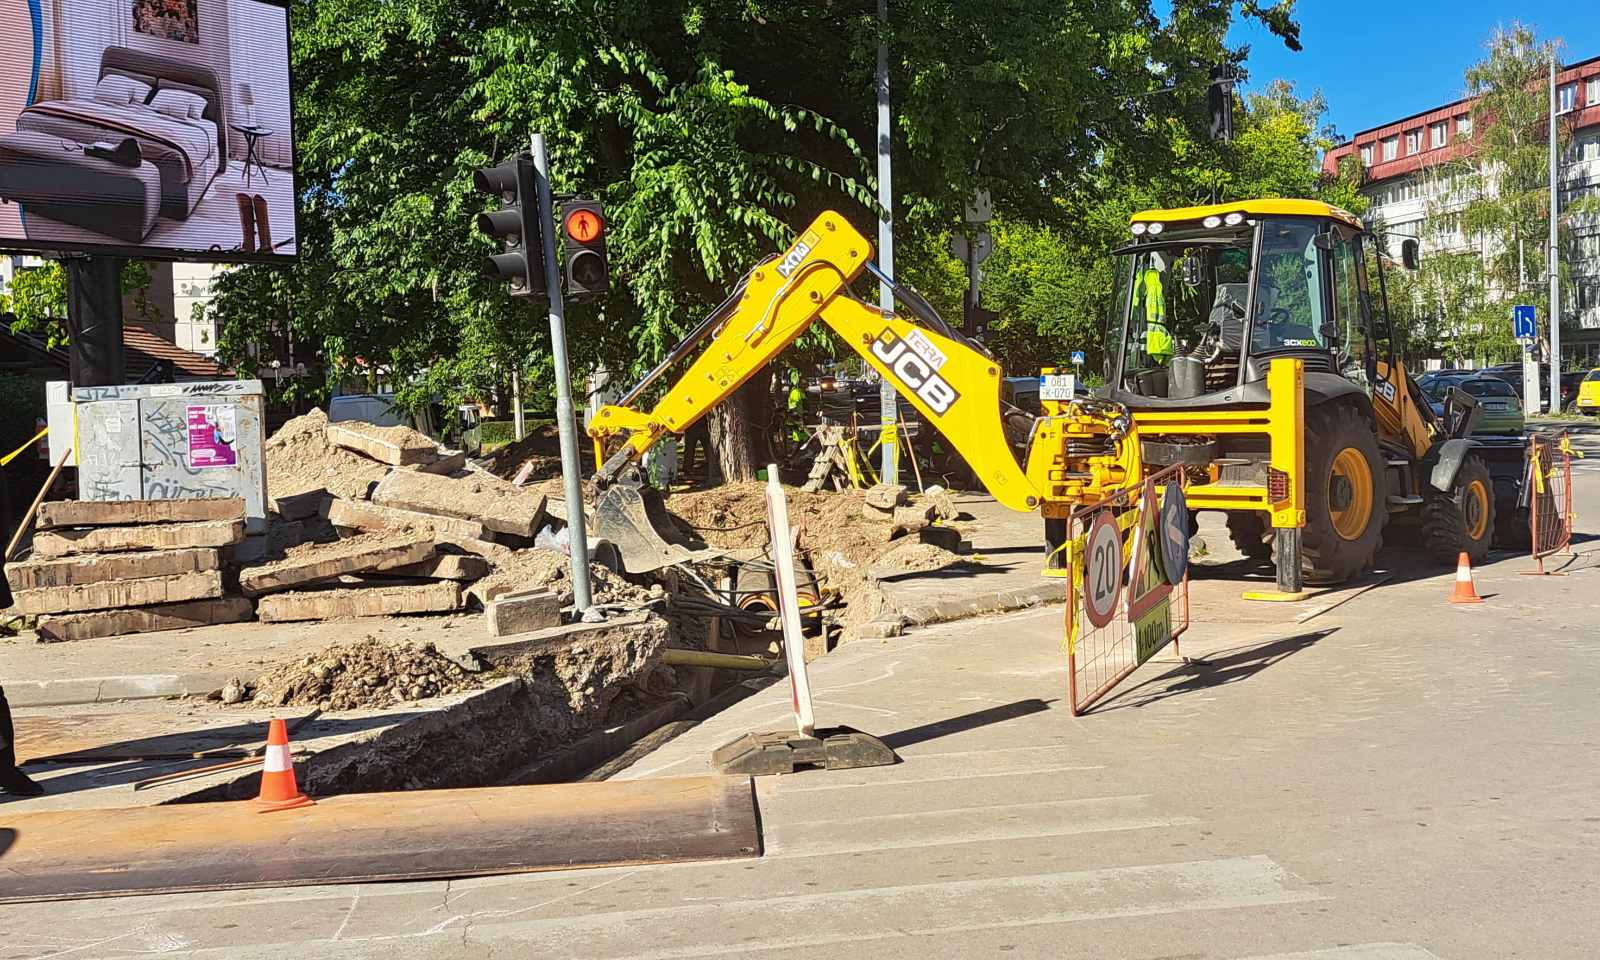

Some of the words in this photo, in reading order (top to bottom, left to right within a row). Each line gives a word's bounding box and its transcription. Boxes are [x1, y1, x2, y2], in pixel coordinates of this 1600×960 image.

[872, 339, 955, 413] JCB
[908, 330, 944, 368] TERRA
[1095, 539, 1115, 600] 20
